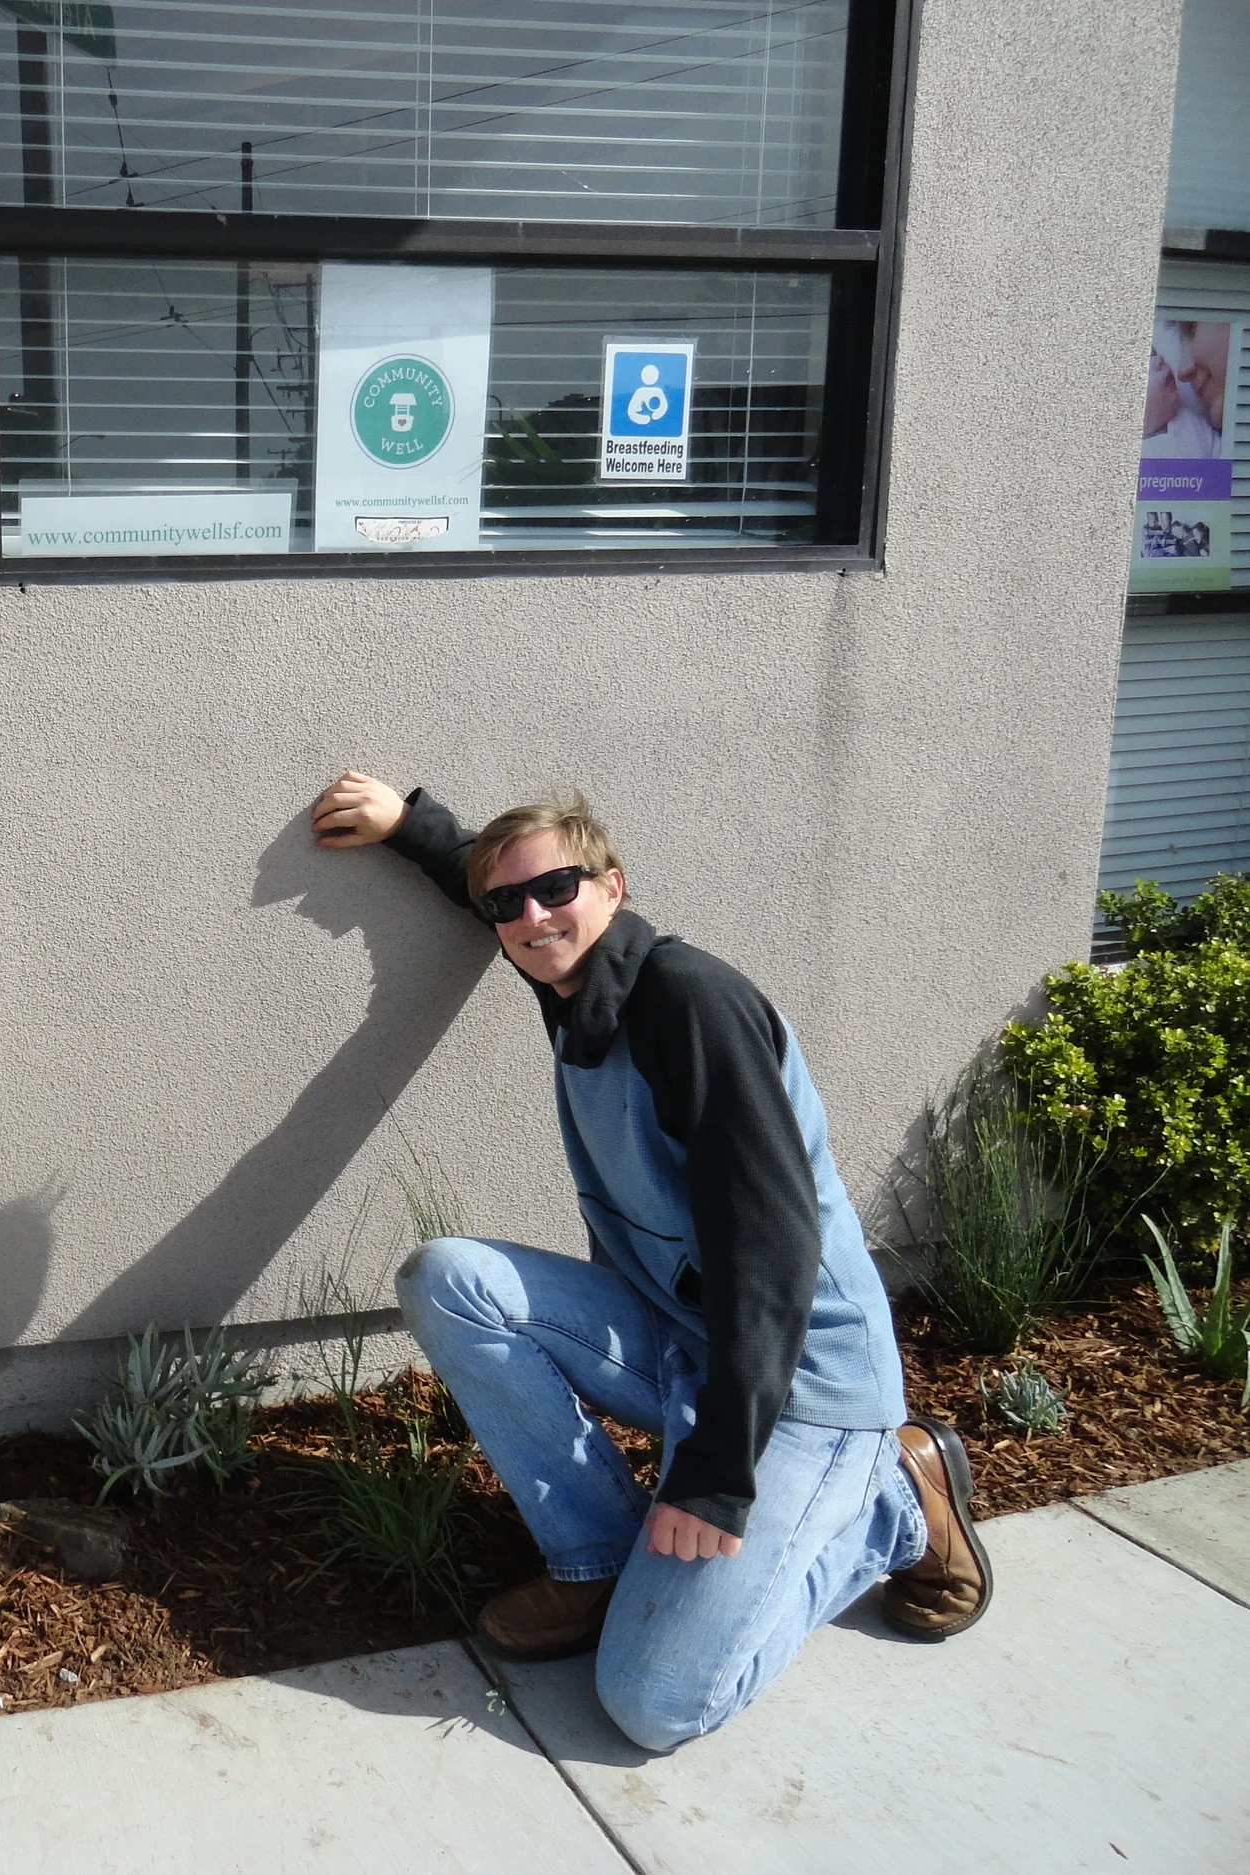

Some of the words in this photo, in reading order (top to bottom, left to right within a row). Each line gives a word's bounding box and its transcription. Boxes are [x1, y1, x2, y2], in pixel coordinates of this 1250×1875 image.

[363, 367, 443, 408] COMMUNITY
[380, 438, 424, 455] WELL
[606, 440, 684, 459] Breastfeeding
[605, 458, 654, 473] Welcome
[657, 458, 683, 474] Here
[1139, 476, 1203, 492] pregnancy
[335, 495, 469, 508] www.communitywellsf.com
[28, 521, 282, 546] www.communitywellsf.com
